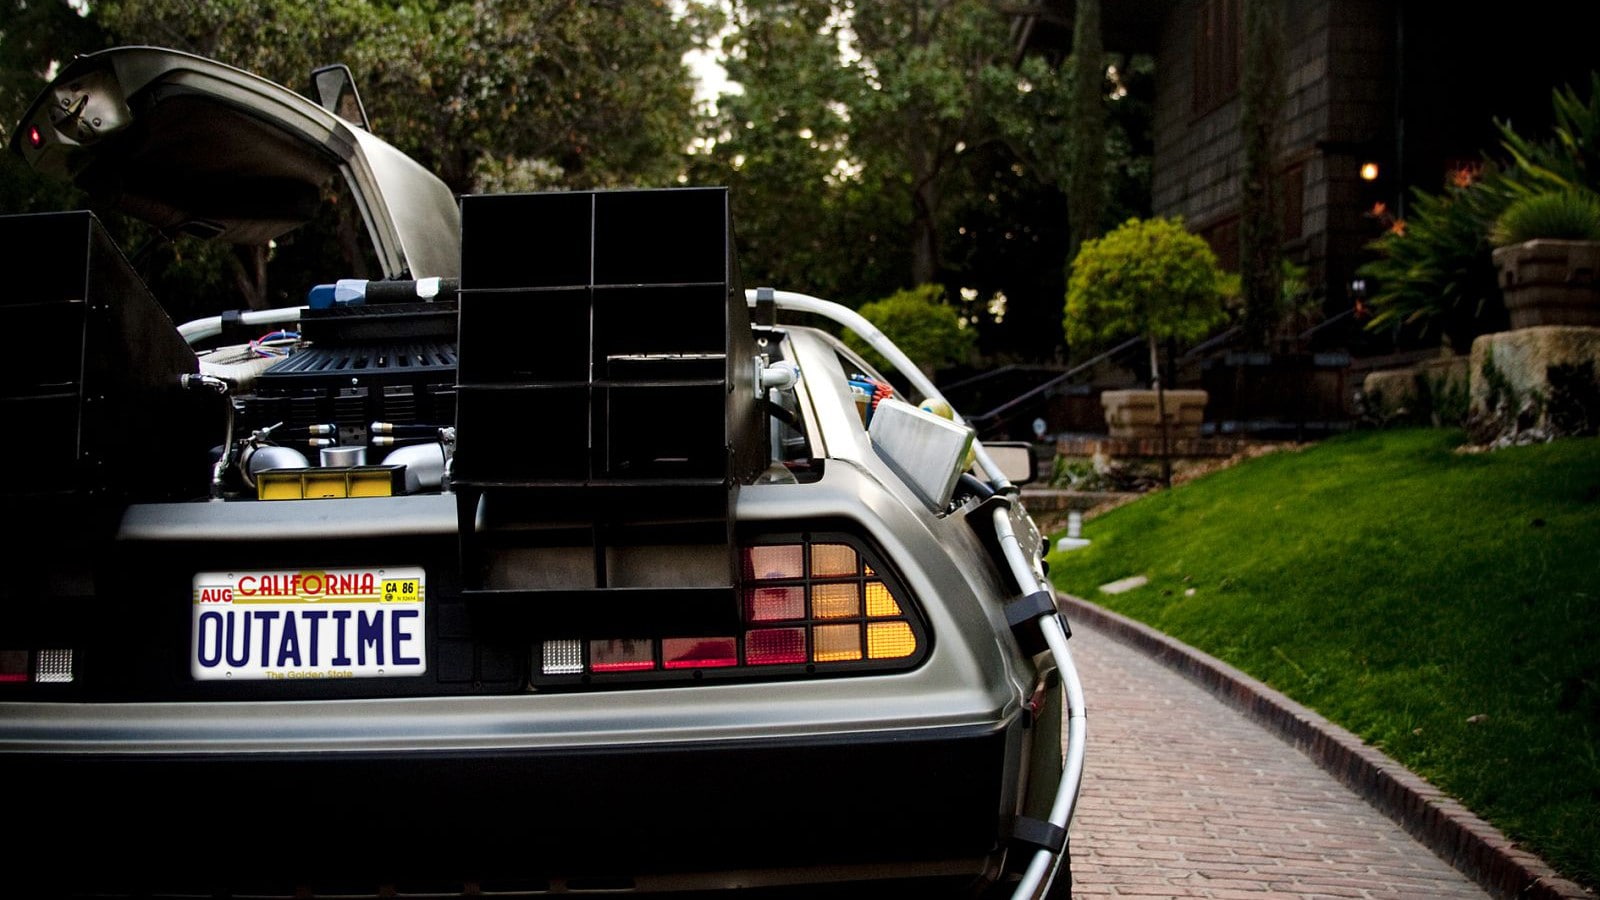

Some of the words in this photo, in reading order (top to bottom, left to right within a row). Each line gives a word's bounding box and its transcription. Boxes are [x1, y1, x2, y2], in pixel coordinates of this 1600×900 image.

[238, 573, 374, 596] CALIFORNIA
[386, 582, 397, 593] CA
[402, 582, 414, 594] 86
[200, 588, 233, 603] AUG
[197, 609, 421, 668] OUTATIME
[265, 671, 284, 680] The
[287, 670, 324, 679] Golden
[327, 670, 353, 679] State
